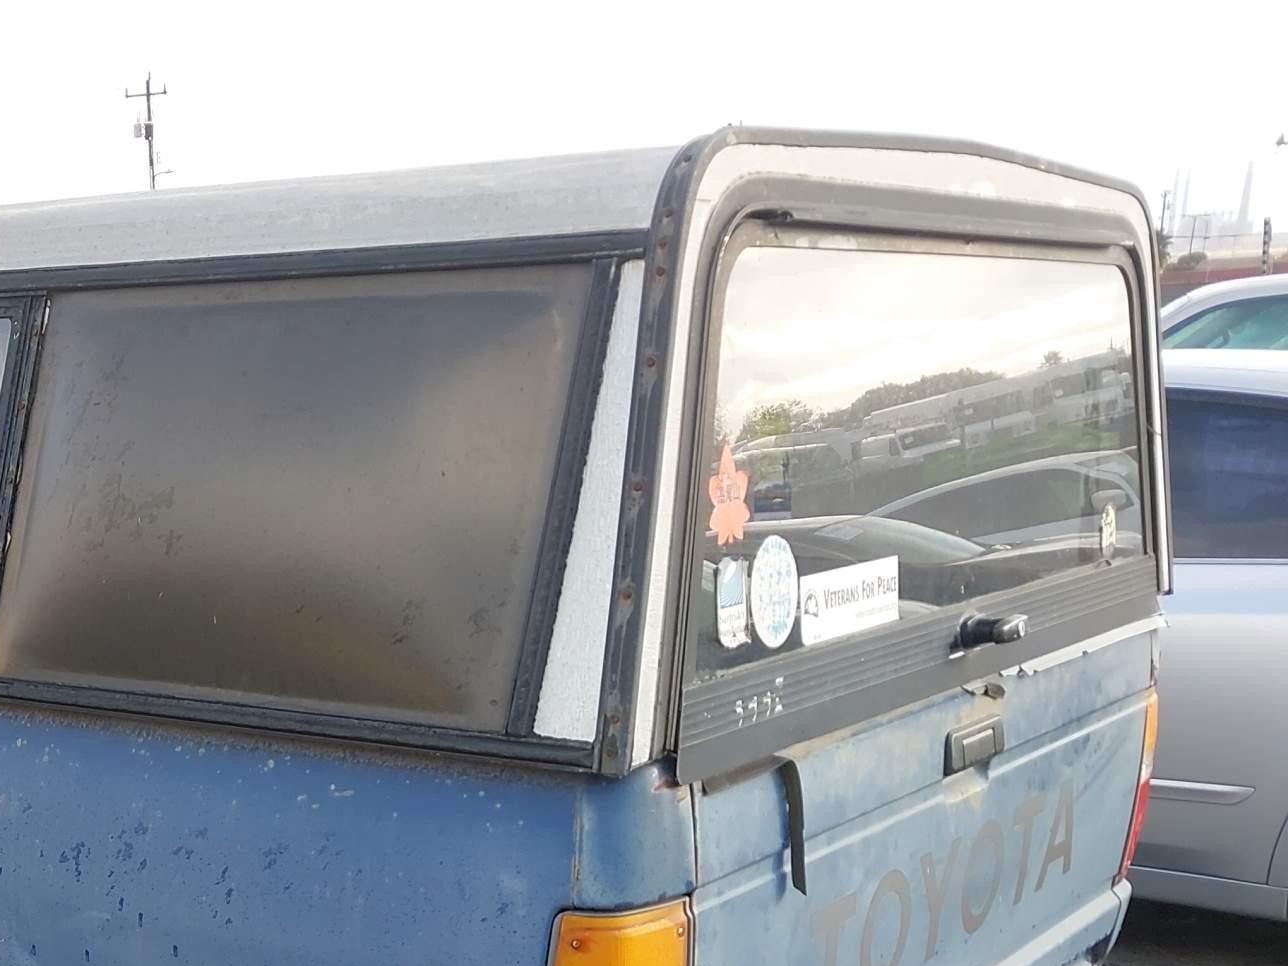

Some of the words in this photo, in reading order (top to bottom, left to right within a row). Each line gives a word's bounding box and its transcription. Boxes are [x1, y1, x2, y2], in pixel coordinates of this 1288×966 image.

[823, 584, 860, 609] VETERANS
[862, 579, 875, 601] FOR
[877, 576, 897, 595] PEACE
